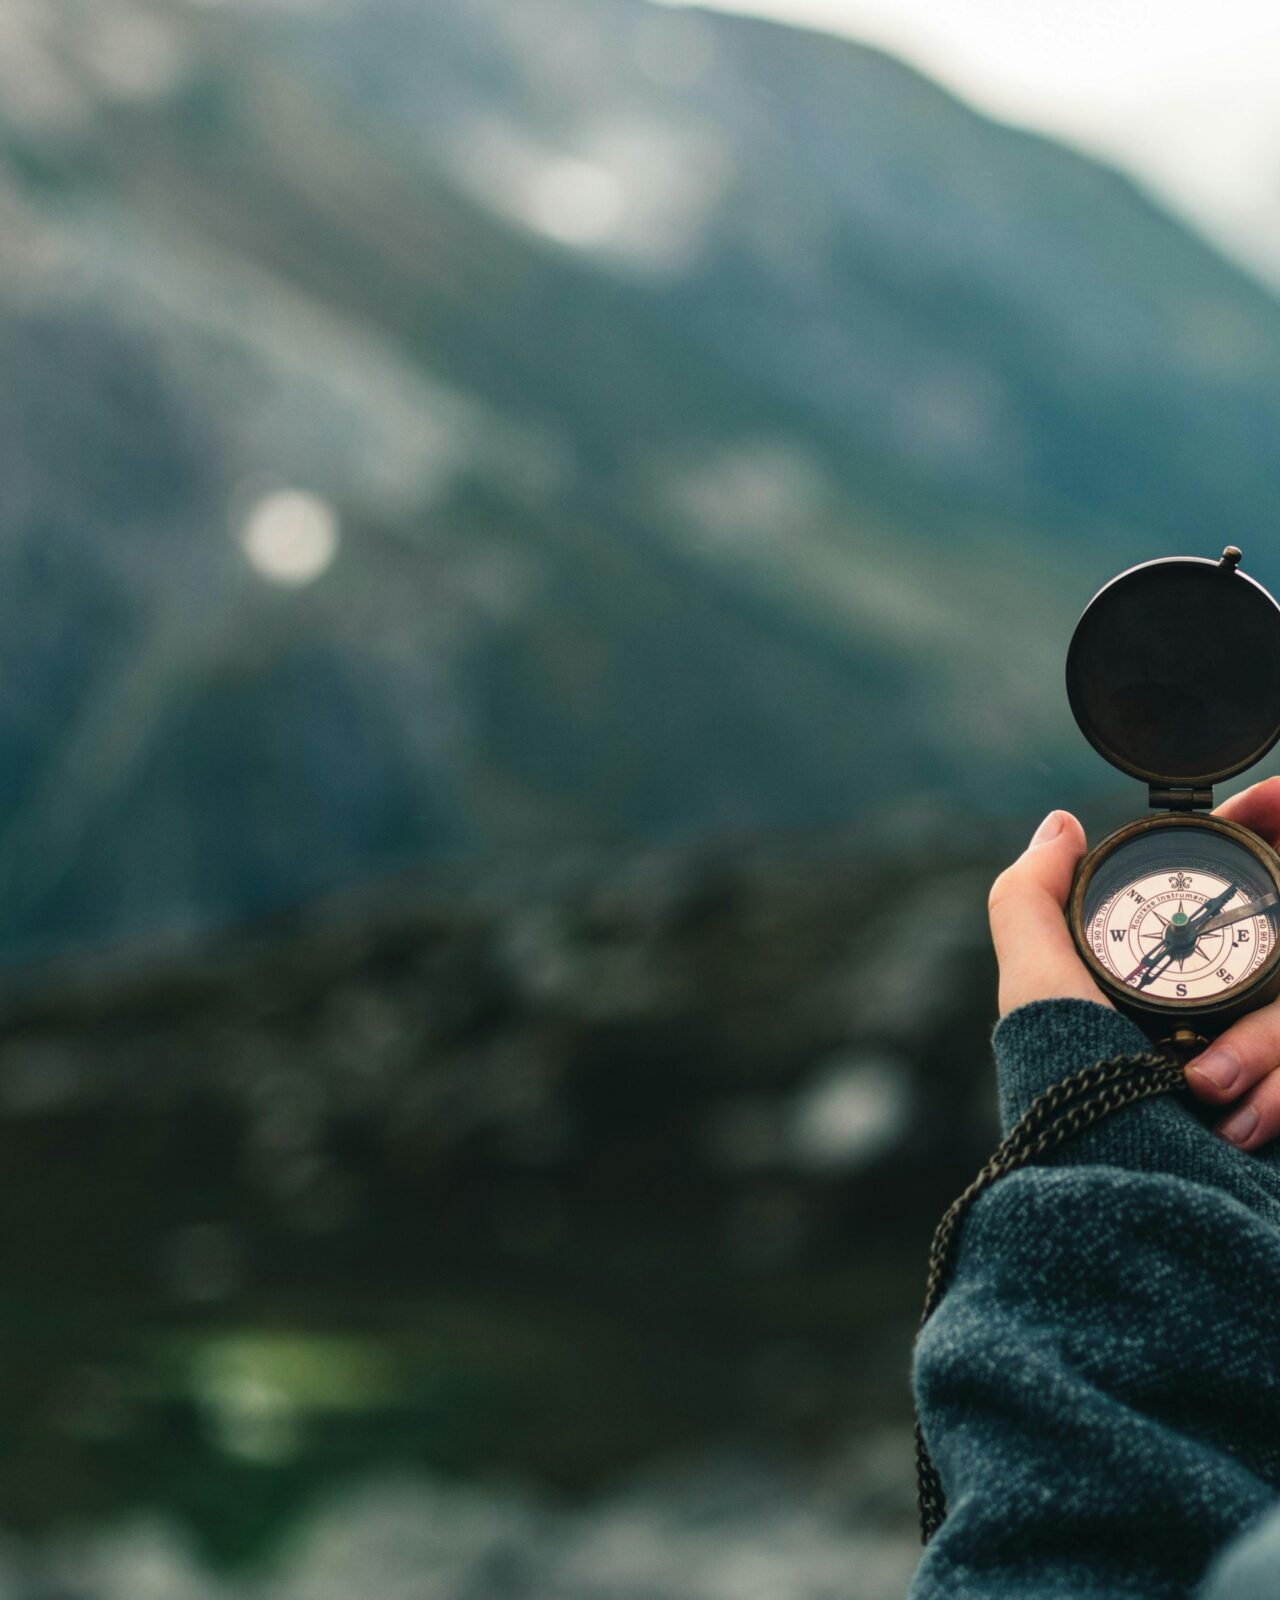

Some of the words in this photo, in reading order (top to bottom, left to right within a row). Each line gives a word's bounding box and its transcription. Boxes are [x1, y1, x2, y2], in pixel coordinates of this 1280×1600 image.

[1127, 889, 1146, 904] NW
[1099, 906, 1107, 915] 70
[1131, 901, 1156, 930] Roorkee
[1095, 918, 1103, 928] 80
[1094, 931, 1101, 940] 90
[1110, 930, 1127, 942] W
[1237, 930, 1250, 942] E
[1260, 931, 1267, 941] 90
[1216, 968, 1234, 984] SE
[1176, 984, 1187, 997] S
